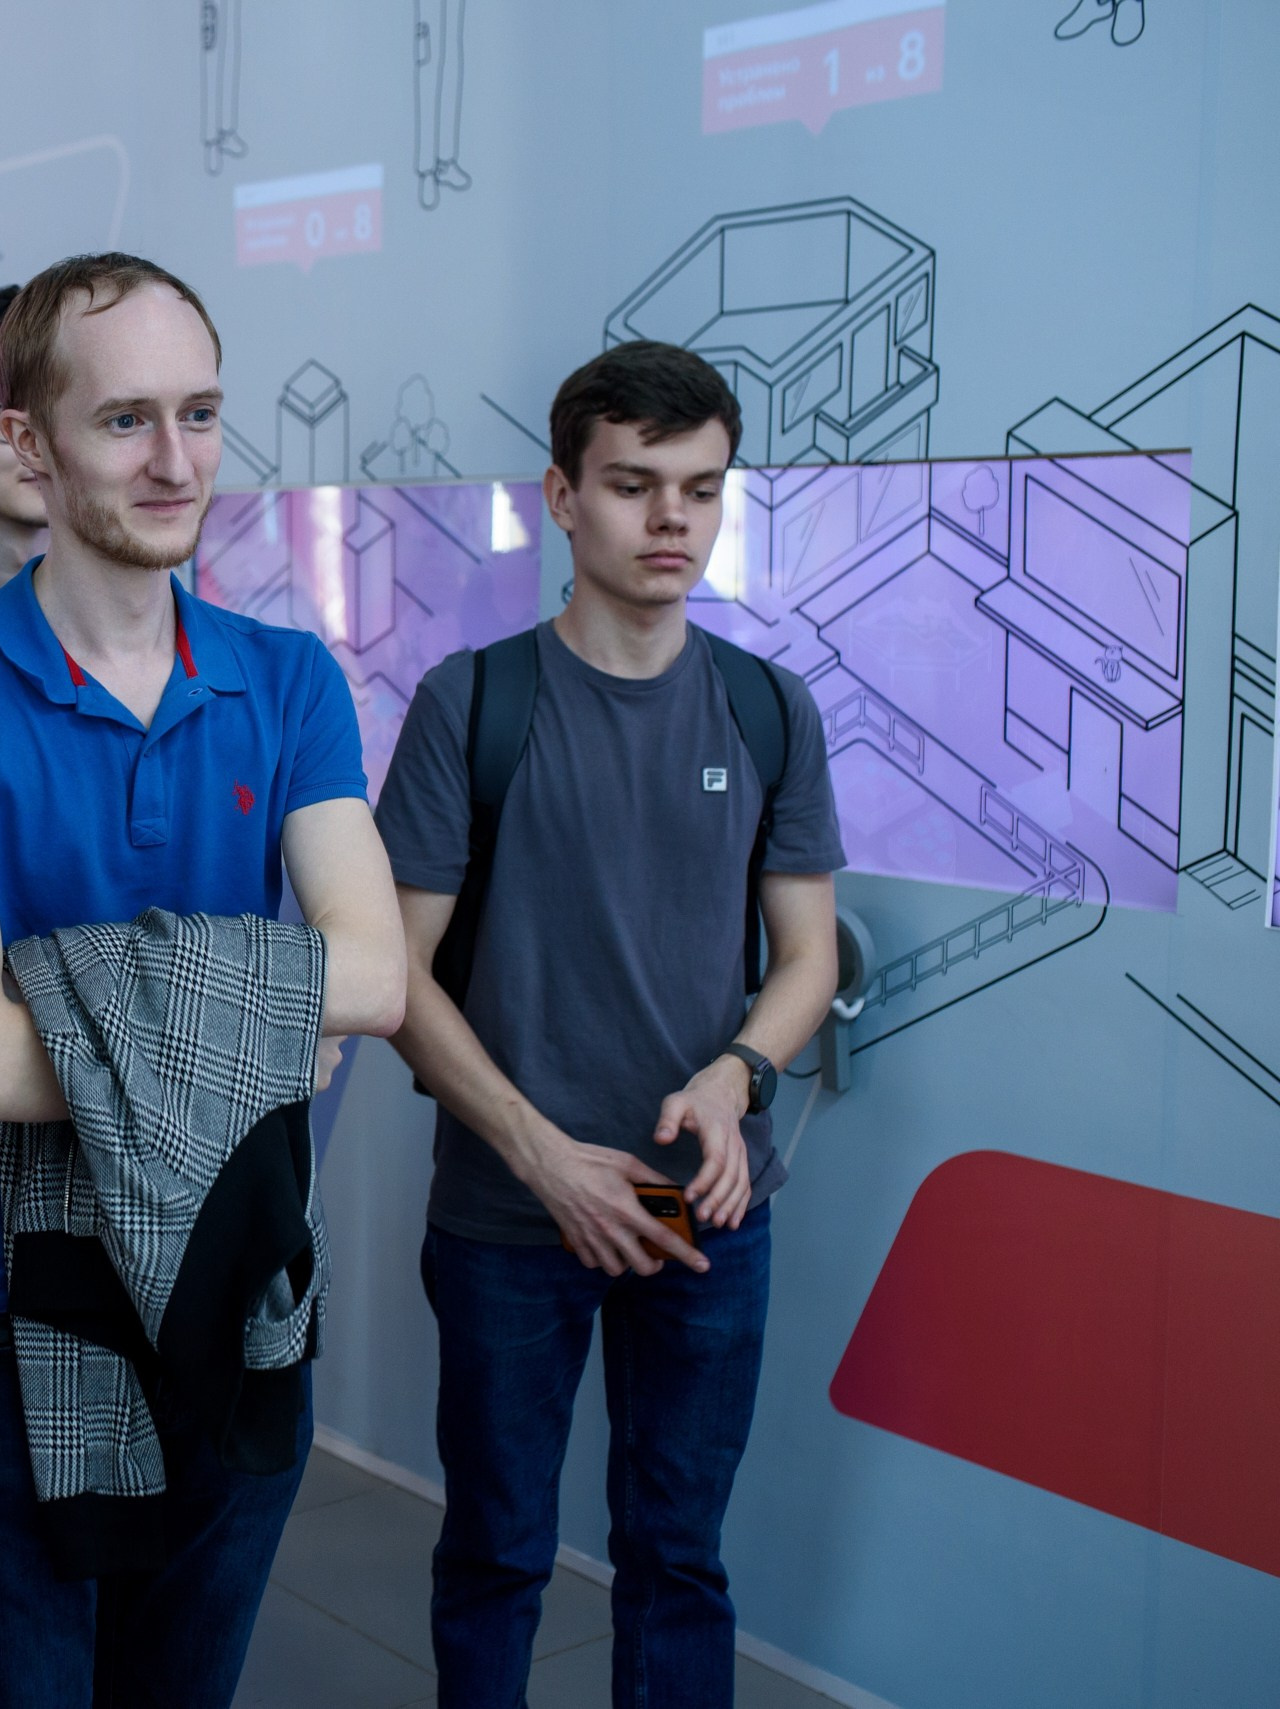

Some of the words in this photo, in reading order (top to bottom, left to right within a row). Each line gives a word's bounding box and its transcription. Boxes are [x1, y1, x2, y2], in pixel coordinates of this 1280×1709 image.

[823, 45, 840, 97] 1
[897, 29, 925, 82] 8
[304, 209, 326, 248] 0
[353, 203, 373, 239] 8
